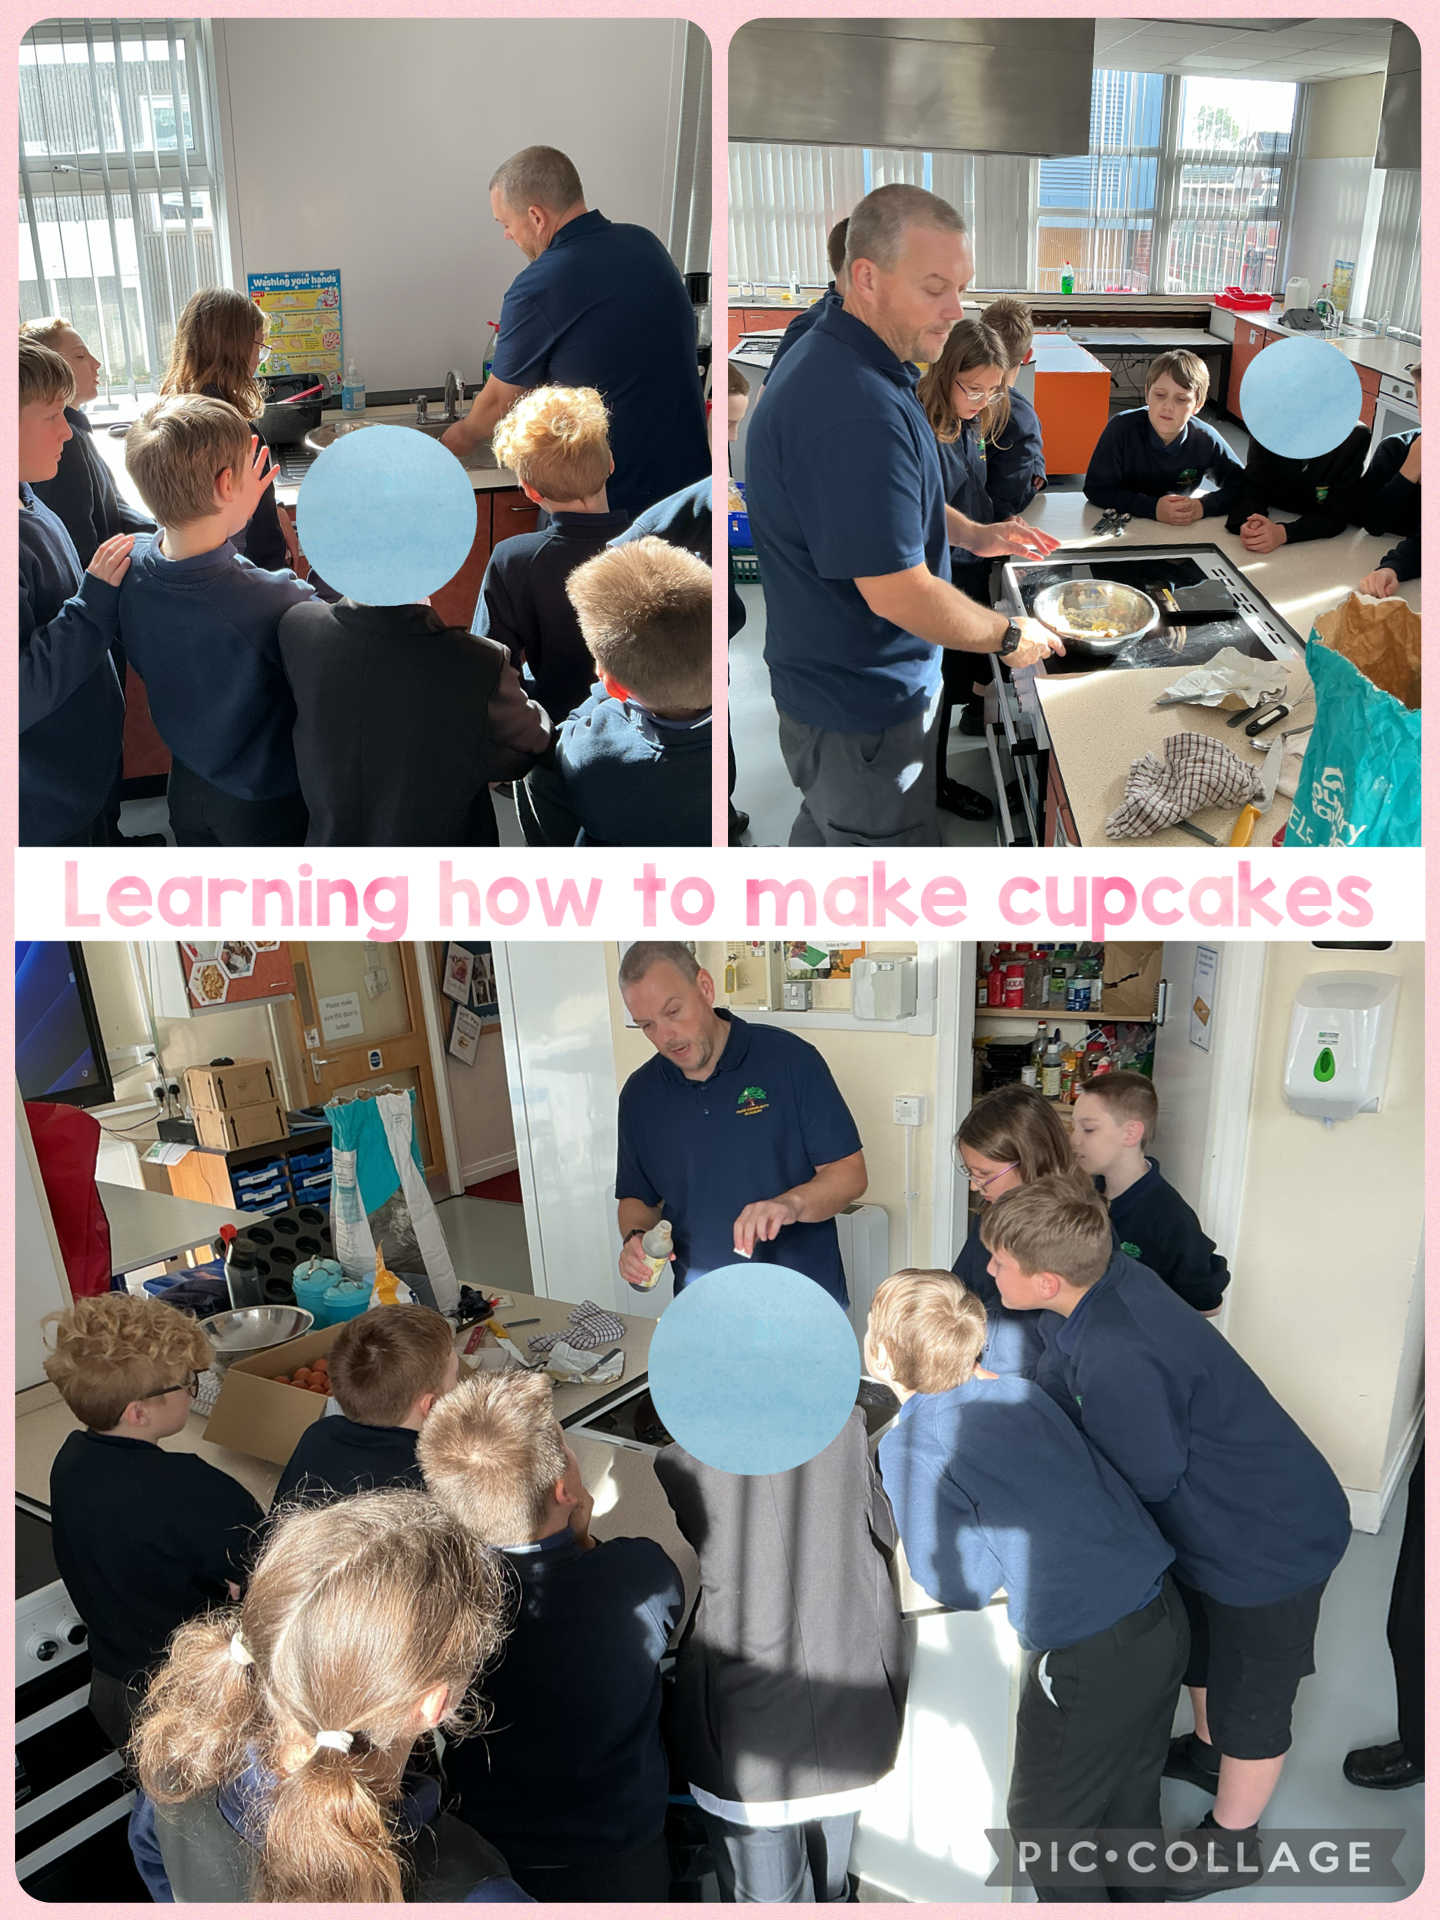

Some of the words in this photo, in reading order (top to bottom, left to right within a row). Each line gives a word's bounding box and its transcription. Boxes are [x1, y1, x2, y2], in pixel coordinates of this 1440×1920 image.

[252, 277, 290, 288] Washing
[291, 277, 310, 287] your
[311, 275, 337, 284] hands
[259, 362, 267, 374] 4
